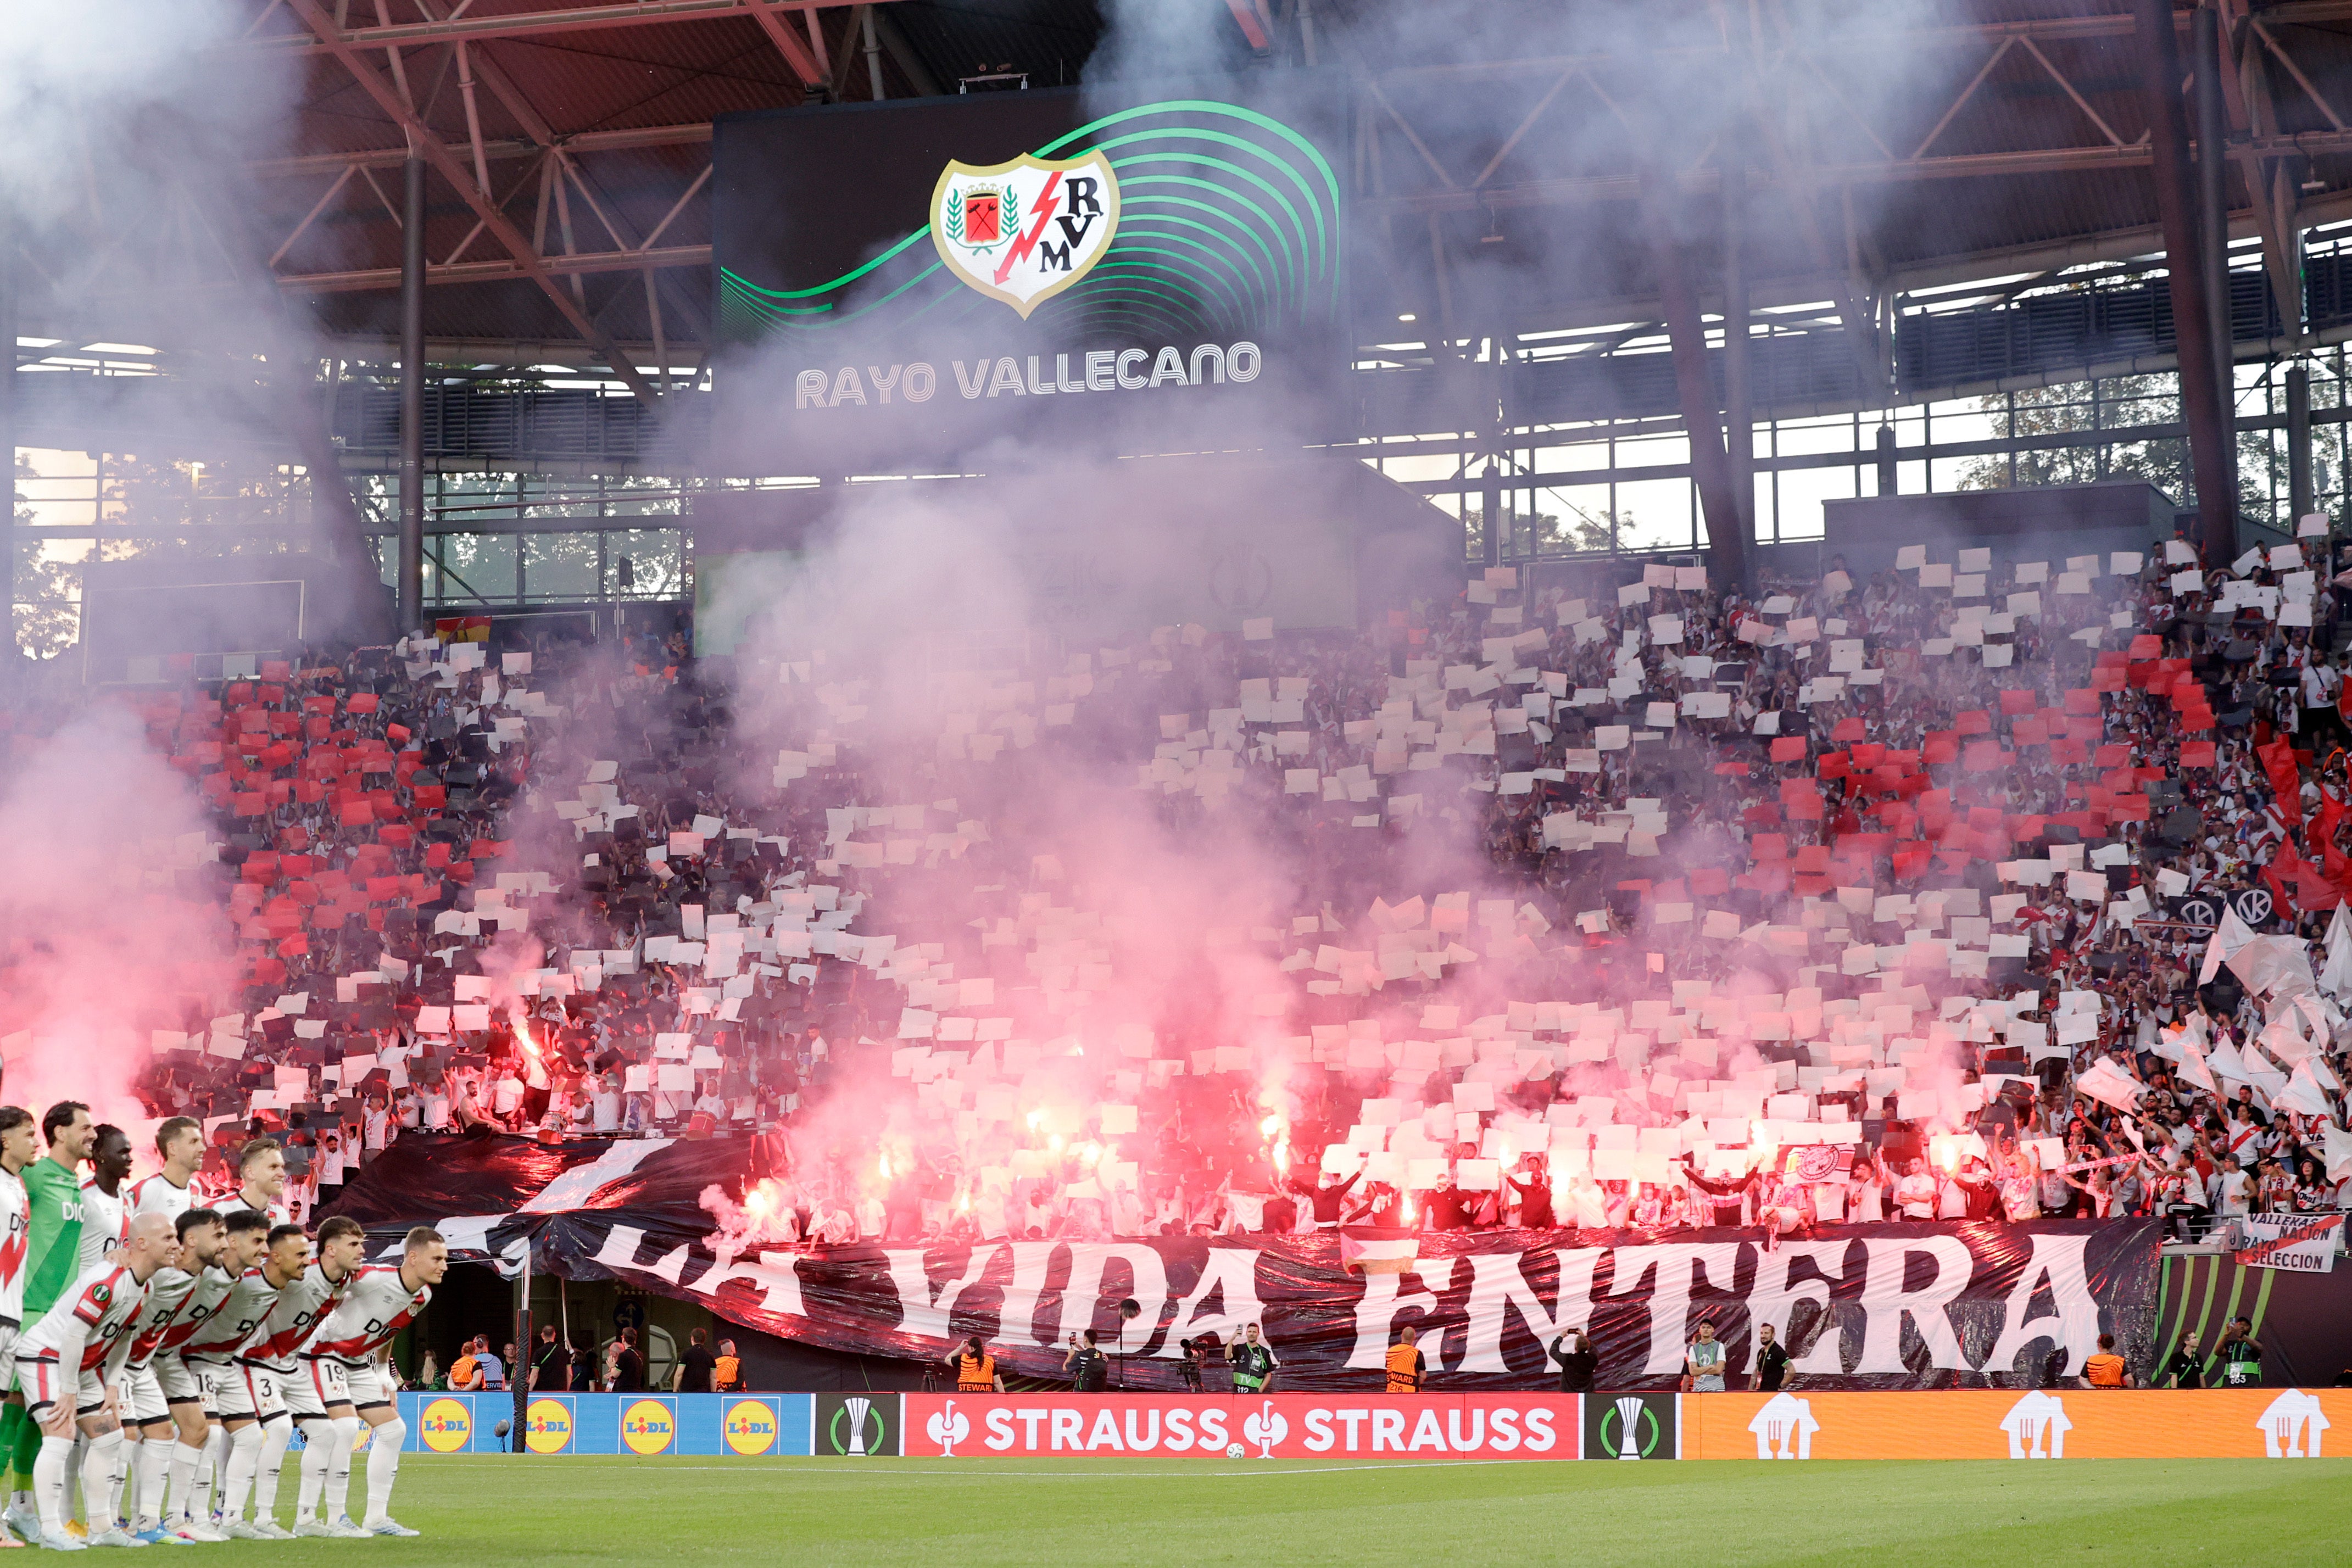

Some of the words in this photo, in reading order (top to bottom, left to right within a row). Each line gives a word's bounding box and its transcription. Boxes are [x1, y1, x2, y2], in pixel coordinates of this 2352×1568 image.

[796, 362, 936, 410] RAYO
[952, 341, 1261, 400] VALLECANO
[2250, 1213, 2318, 1227] VALLEKAS
[2242, 1236, 2277, 1251] RAYO
[883, 1241, 1273, 1359] VIDA
[1342, 1234, 2099, 1376] ENTERA
[324, 1364, 345, 1382] 19
[1240, 1375, 1252, 1384] TV
[195, 1374, 213, 1393] 18
[260, 1379, 272, 1397] 3
[984, 1407, 1229, 1451] STRAUSS
[1303, 1407, 1556, 1452] STRAUSS
